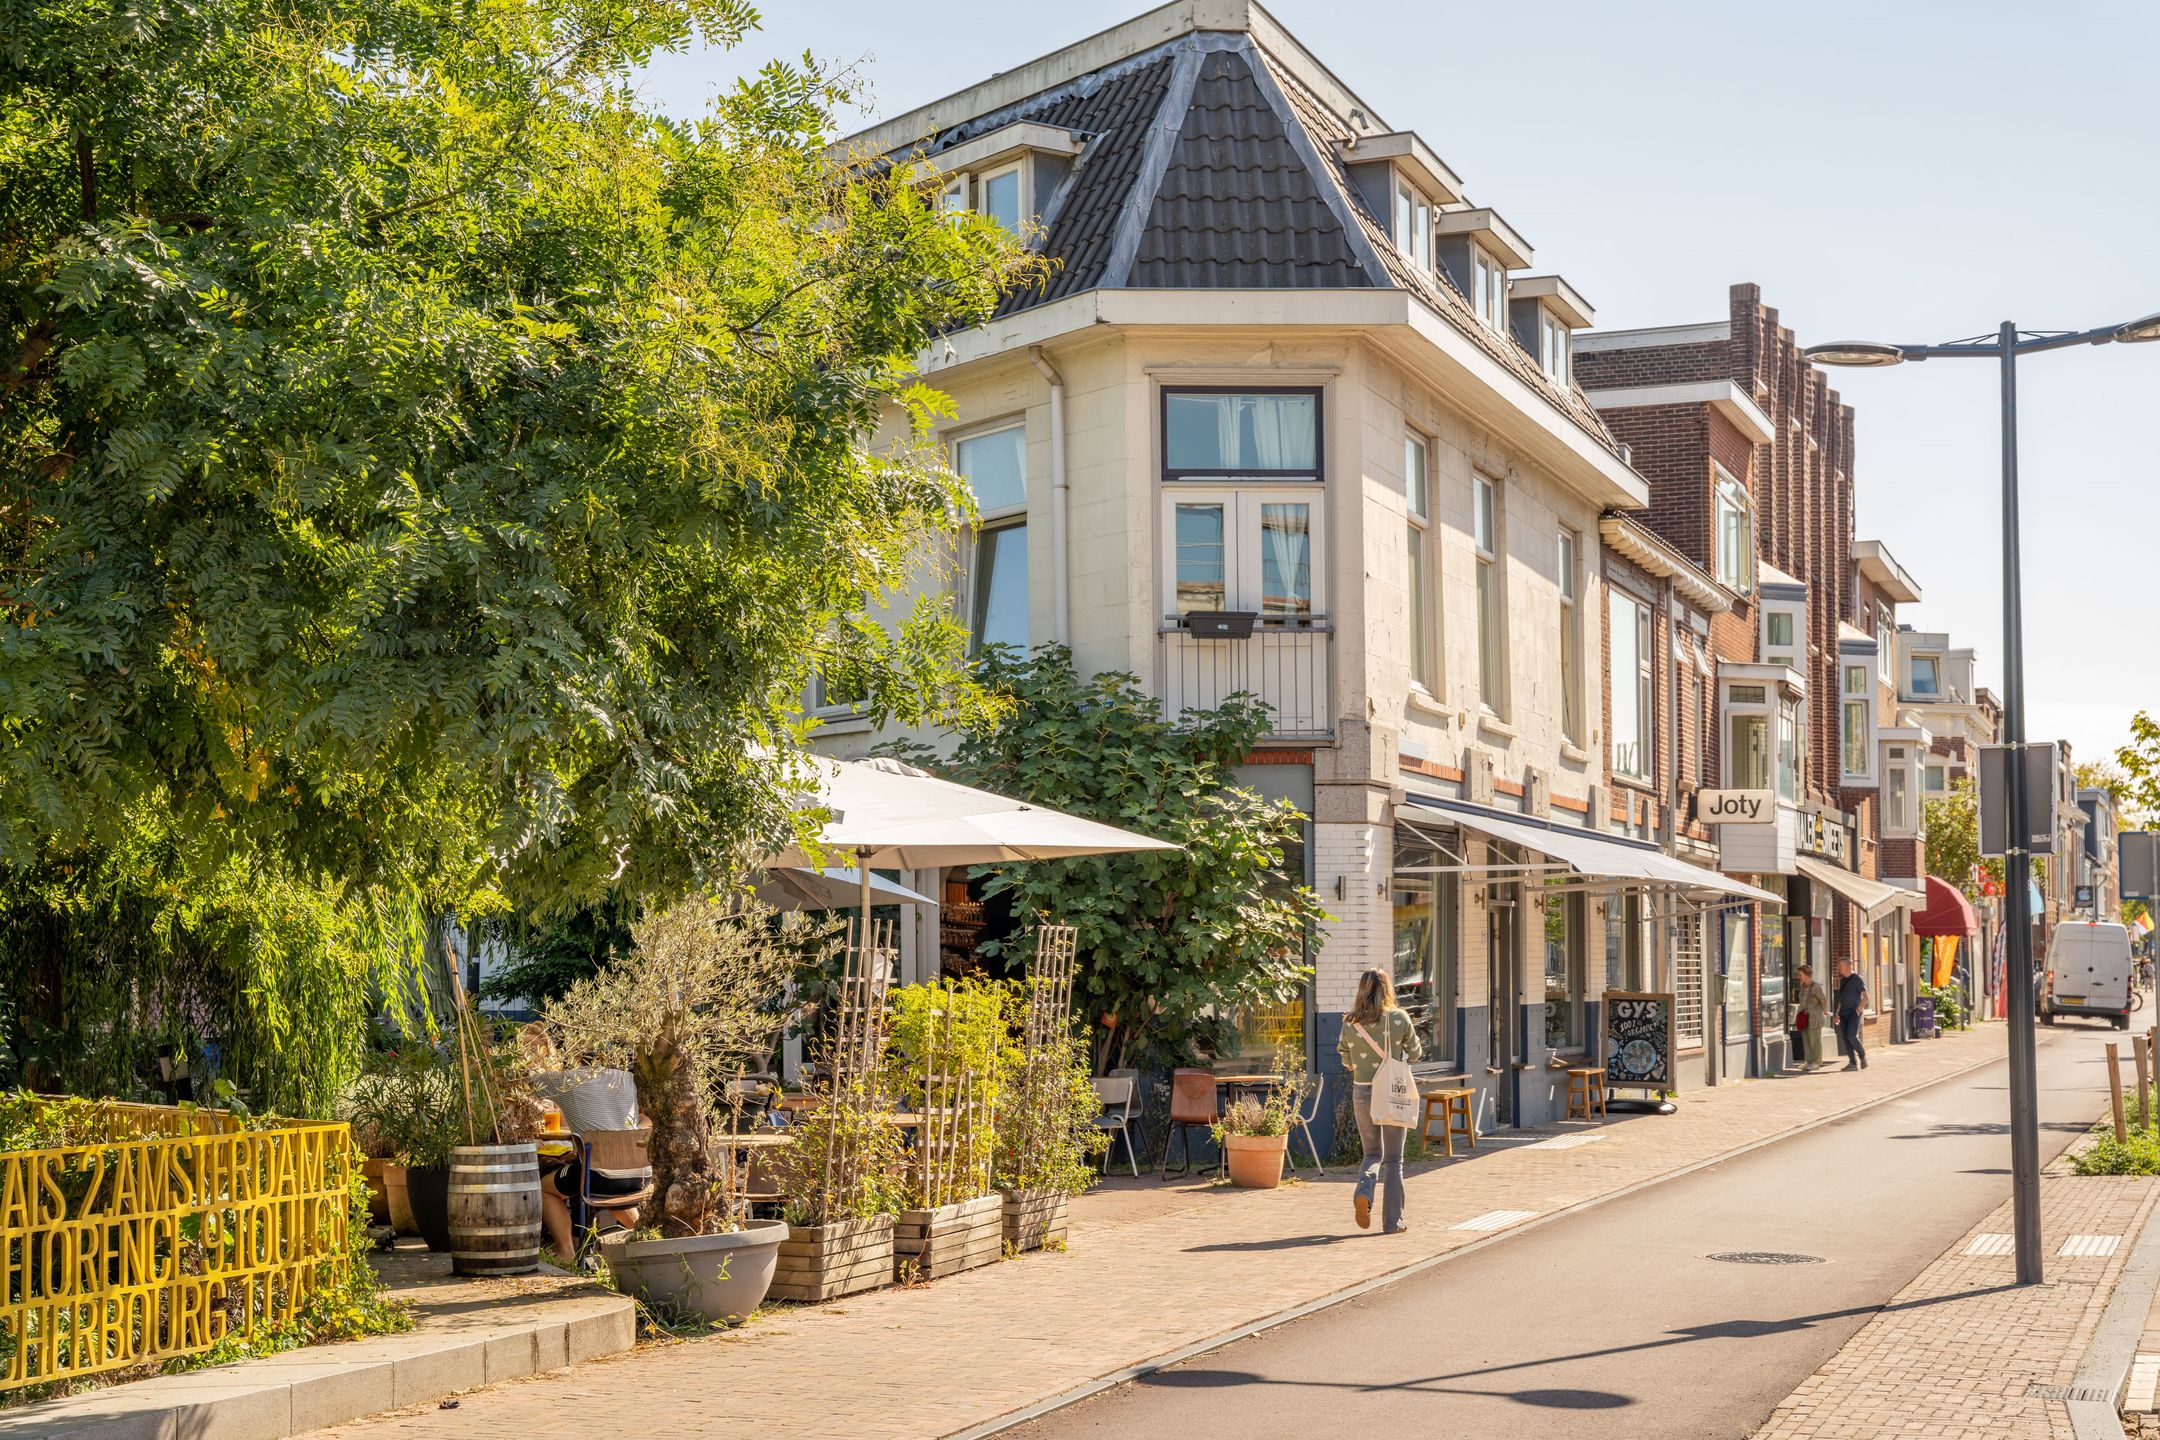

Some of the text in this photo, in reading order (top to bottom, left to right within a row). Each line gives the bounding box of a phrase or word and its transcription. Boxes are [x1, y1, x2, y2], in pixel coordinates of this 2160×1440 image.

[1709, 794, 1762, 819] Joty
[1617, 1001, 1657, 1018] GYS
[2, 1213, 189, 1307] FLORENCE
[0, 1280, 227, 1383] CHERBOURG
